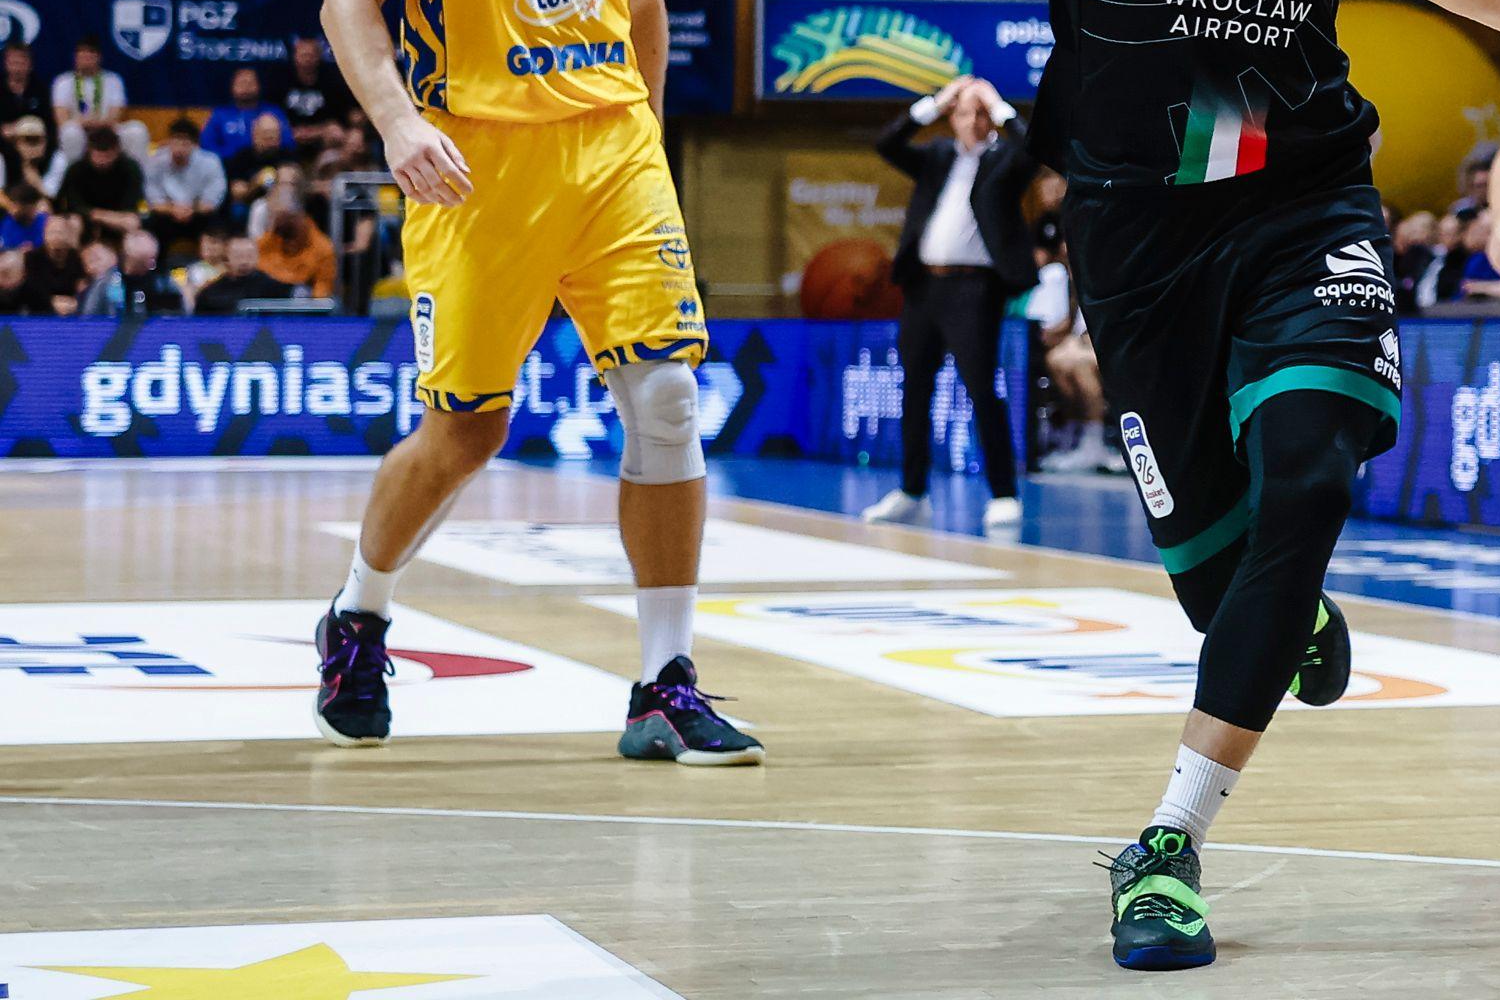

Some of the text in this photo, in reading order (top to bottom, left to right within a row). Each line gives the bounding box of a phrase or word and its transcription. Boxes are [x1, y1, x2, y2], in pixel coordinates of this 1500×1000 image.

[1169, 14, 1296, 48] AIRPORT
[507, 41, 626, 77] GDYNIA
[1313, 283, 1396, 307] aquapark
